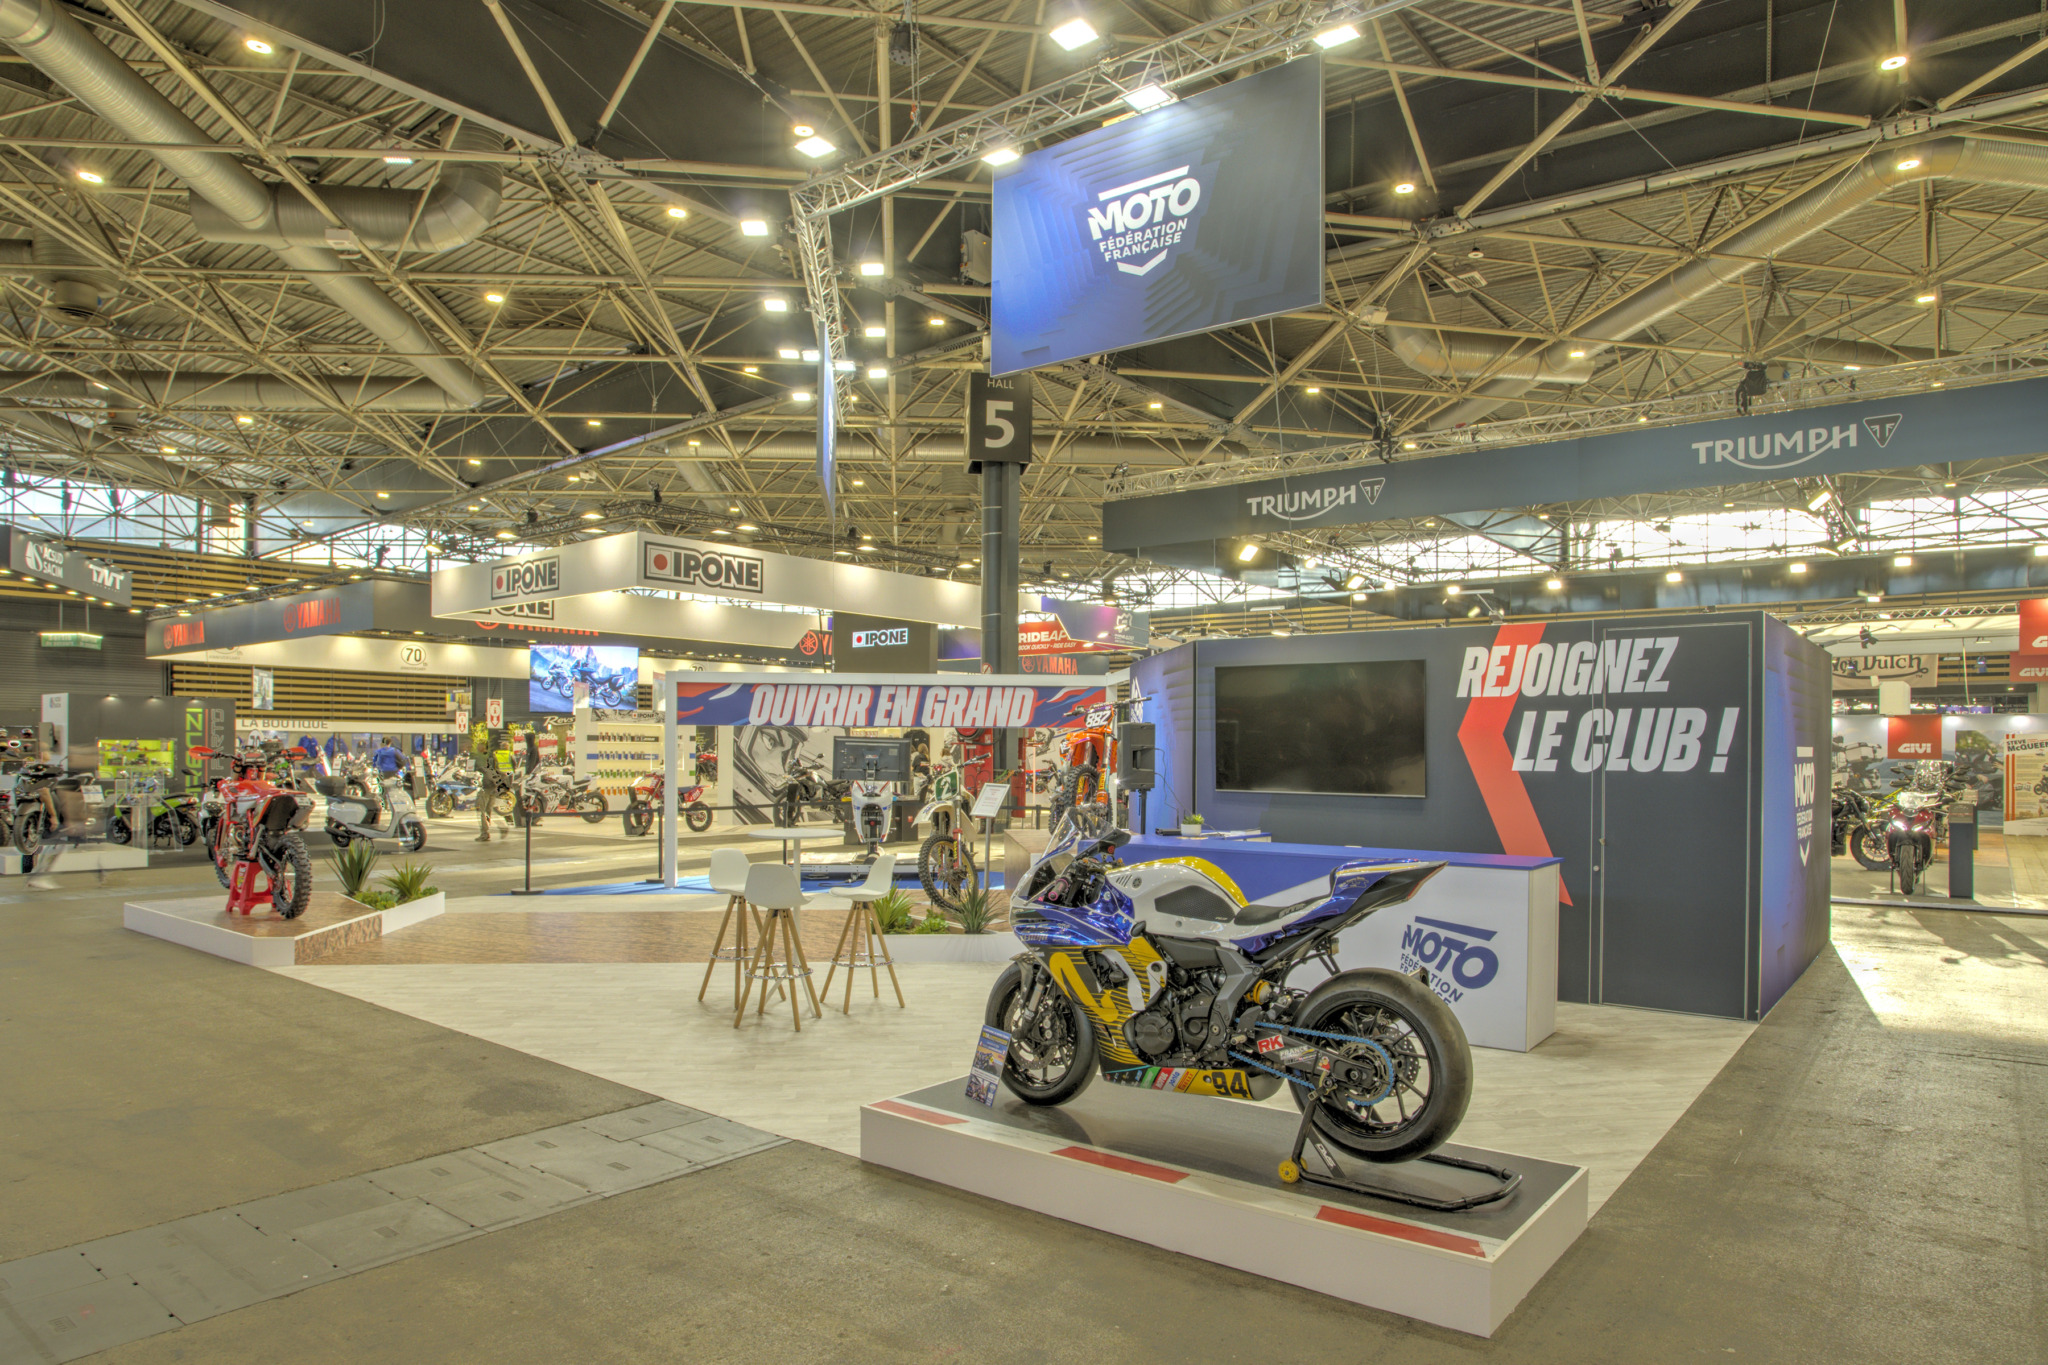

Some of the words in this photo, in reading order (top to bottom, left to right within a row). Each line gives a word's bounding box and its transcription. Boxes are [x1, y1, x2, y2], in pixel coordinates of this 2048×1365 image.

[1087, 177, 1201, 241] MOTO
[1099, 218, 1188, 253] FÉDÉRATION
[1104, 231, 1182, 262] FRANÇAISE
[987, 378, 1014, 389] HALL
[984, 399, 1015, 449] 5
[1691, 423, 1858, 470] TRIUMPH
[1246, 484, 1357, 521] TRIUMPH
[43, 547, 64, 565] ACSUD
[43, 561, 63, 578] SACIM
[674, 551, 759, 587] IPONE
[505, 560, 558, 593] IPONE
[297, 597, 341, 629] YAMAHA
[172, 620, 205, 647] YAMAHA
[864, 630, 907, 646] IPONE
[405, 648, 422, 662] 70
[1035, 656, 1078, 675] YAMAHA
[1456, 636, 1680, 698] REJOIGNEZ
[748, 684, 872, 726] OUVRIR
[873, 686, 922, 727] EN
[921, 686, 1035, 727] GRAND
[1086, 710, 1111, 728] 882
[241, 719, 258, 728] LA
[262, 719, 328, 729] BOUTIQUE
[1511, 710, 1569, 772] LE
[1570, 707, 1708, 773] CLUB
[1709, 707, 1741, 773] !
[1898, 743, 1932, 754] GIVI
[1794, 762, 1816, 808] MOTO
[1401, 924, 1499, 990] MOTO
[1400, 952, 1464, 1003] FÉDÉTION
[1257, 1035, 1284, 1054] RK
[1211, 1071, 1249, 1099] 94
